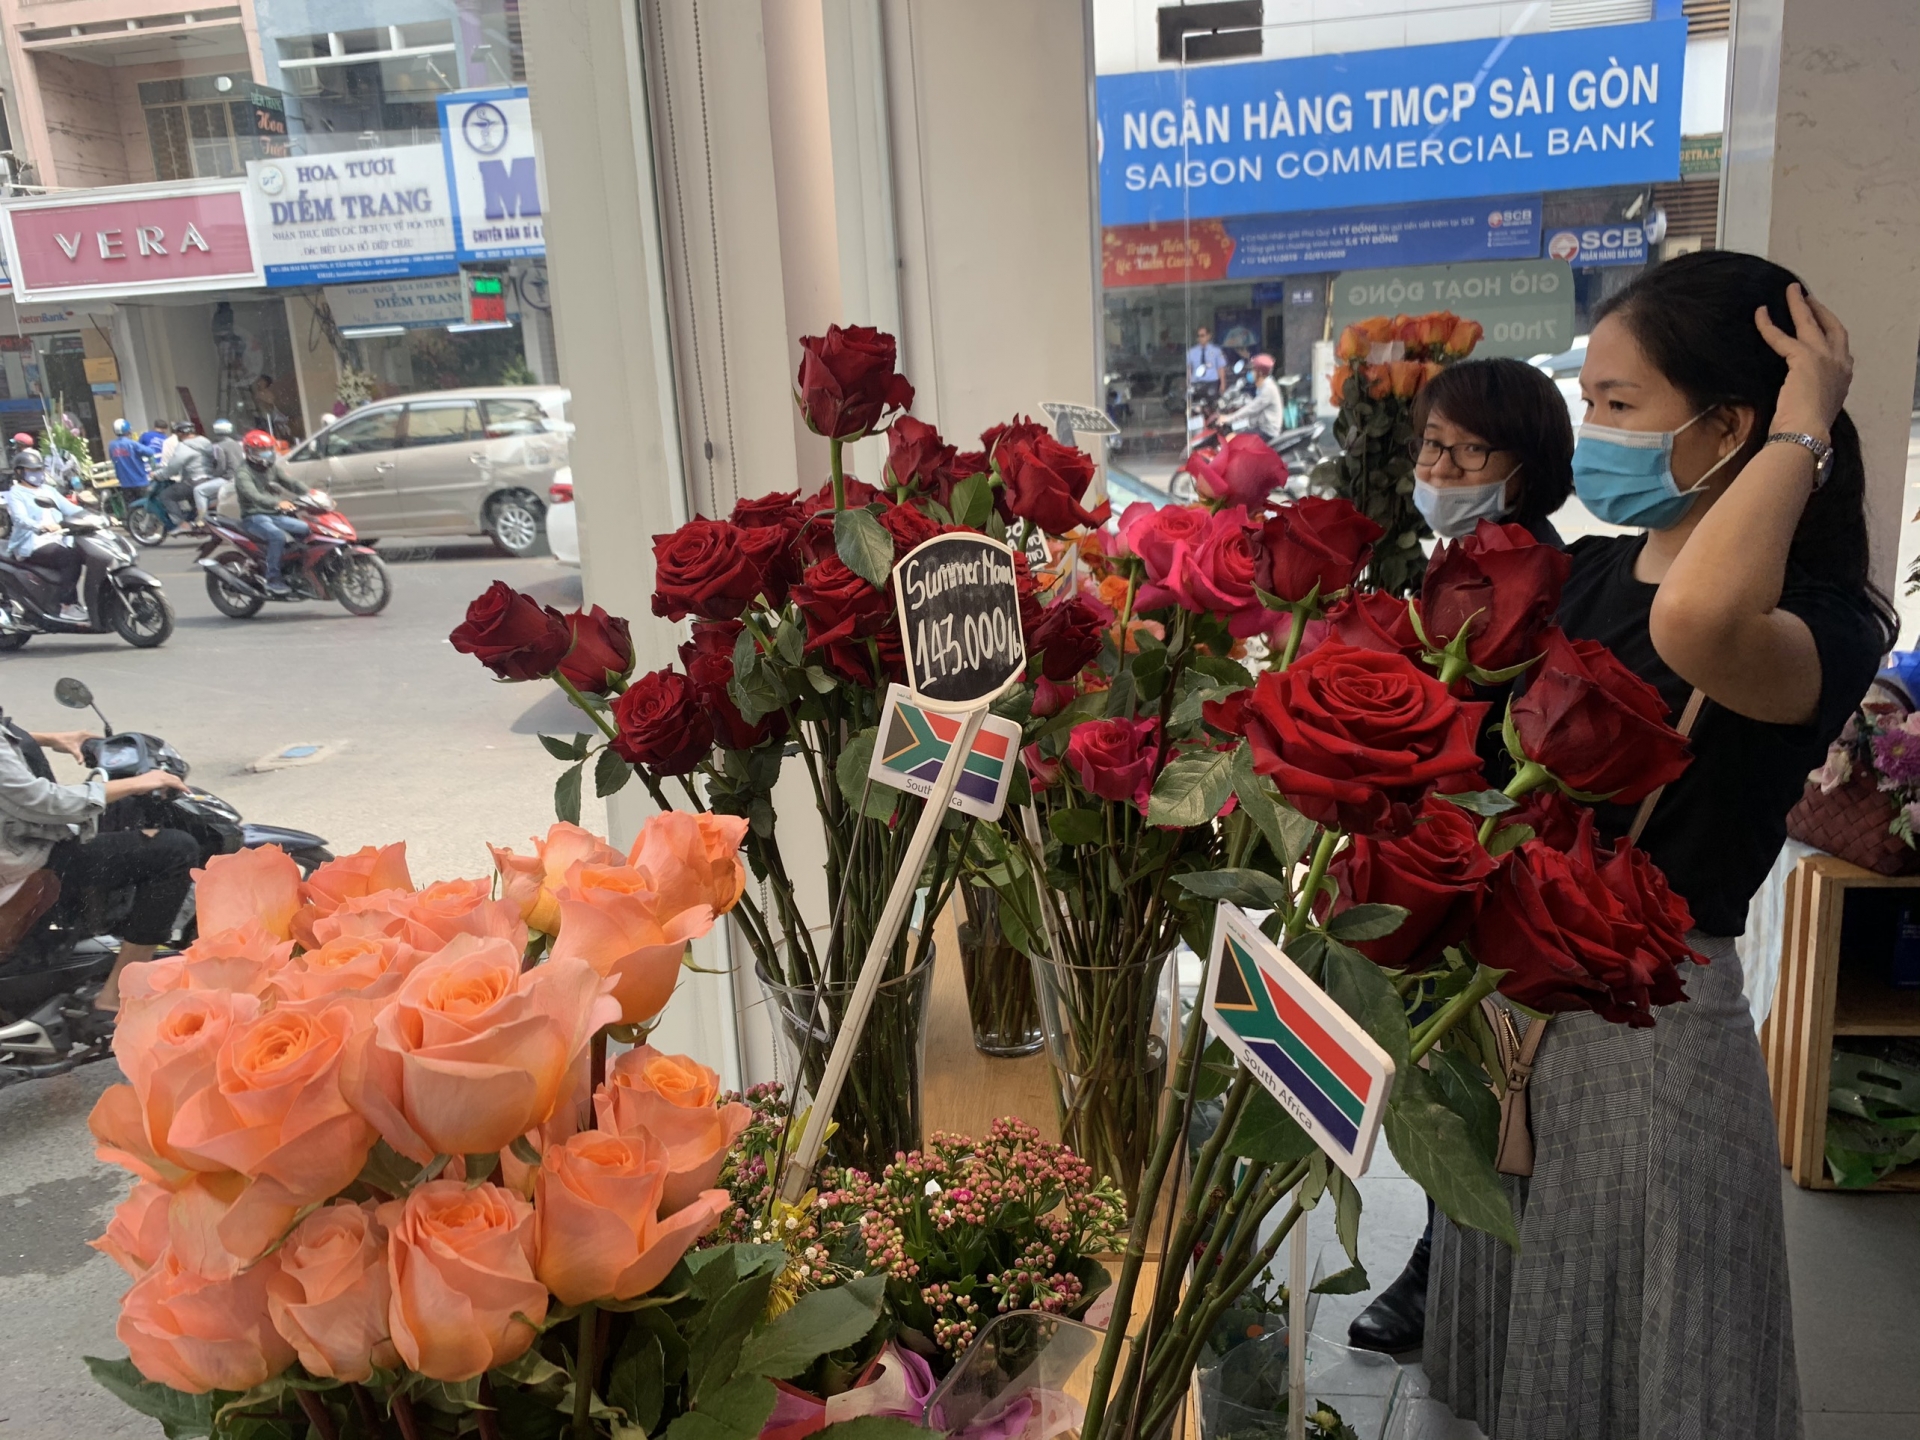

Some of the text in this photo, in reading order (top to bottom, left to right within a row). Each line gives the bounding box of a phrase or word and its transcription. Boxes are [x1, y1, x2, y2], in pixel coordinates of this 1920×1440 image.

[1123, 56, 1659, 150] NGÂN HÀNG TMCP SÀI GÒN
[296, 158, 396, 183] HOA TƯƠI
[1125, 119, 1655, 191] SAIGON COMMERCIAL BANK
[270, 188, 432, 226] DIỄM TRANG
[1503, 209, 1532, 221] SCB
[54, 222, 210, 261] VERA
[1581, 227, 1643, 250] SCB
[1599, 248, 1616, 260] HÀNG
[374, 293, 414, 309] DIỄM
[906, 559, 981, 611] Summer
[906, 778, 933, 796] South
[1243, 1048, 1314, 1131] South Africa
